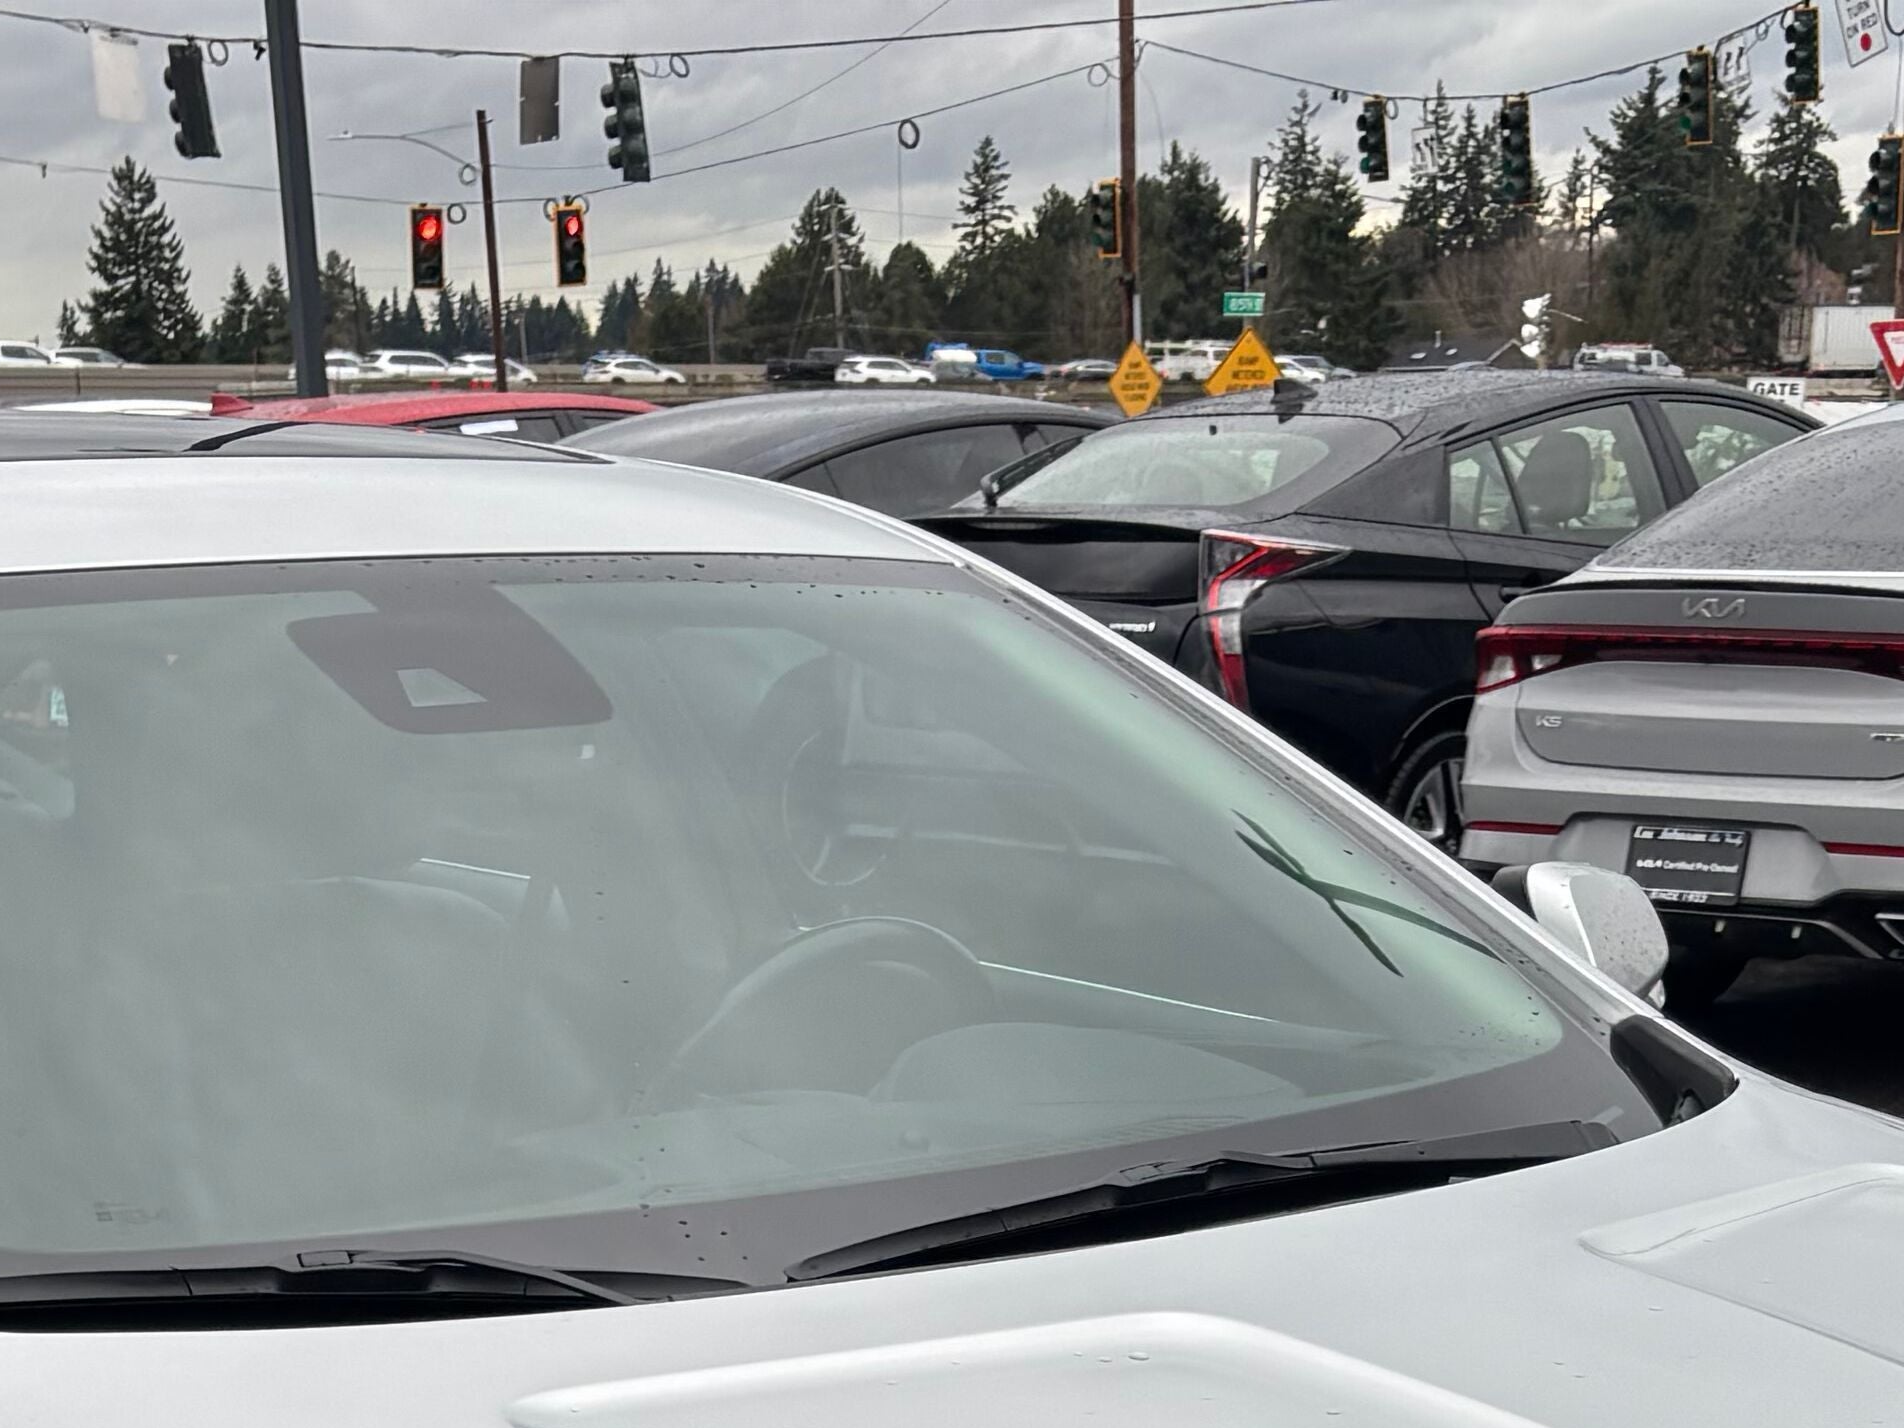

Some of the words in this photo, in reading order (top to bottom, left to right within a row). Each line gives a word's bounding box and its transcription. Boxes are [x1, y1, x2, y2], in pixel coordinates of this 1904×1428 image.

[1860, 12, 1878, 30] RED
[1752, 382, 1800, 397] GATE
[1681, 598, 1746, 618] KIA
